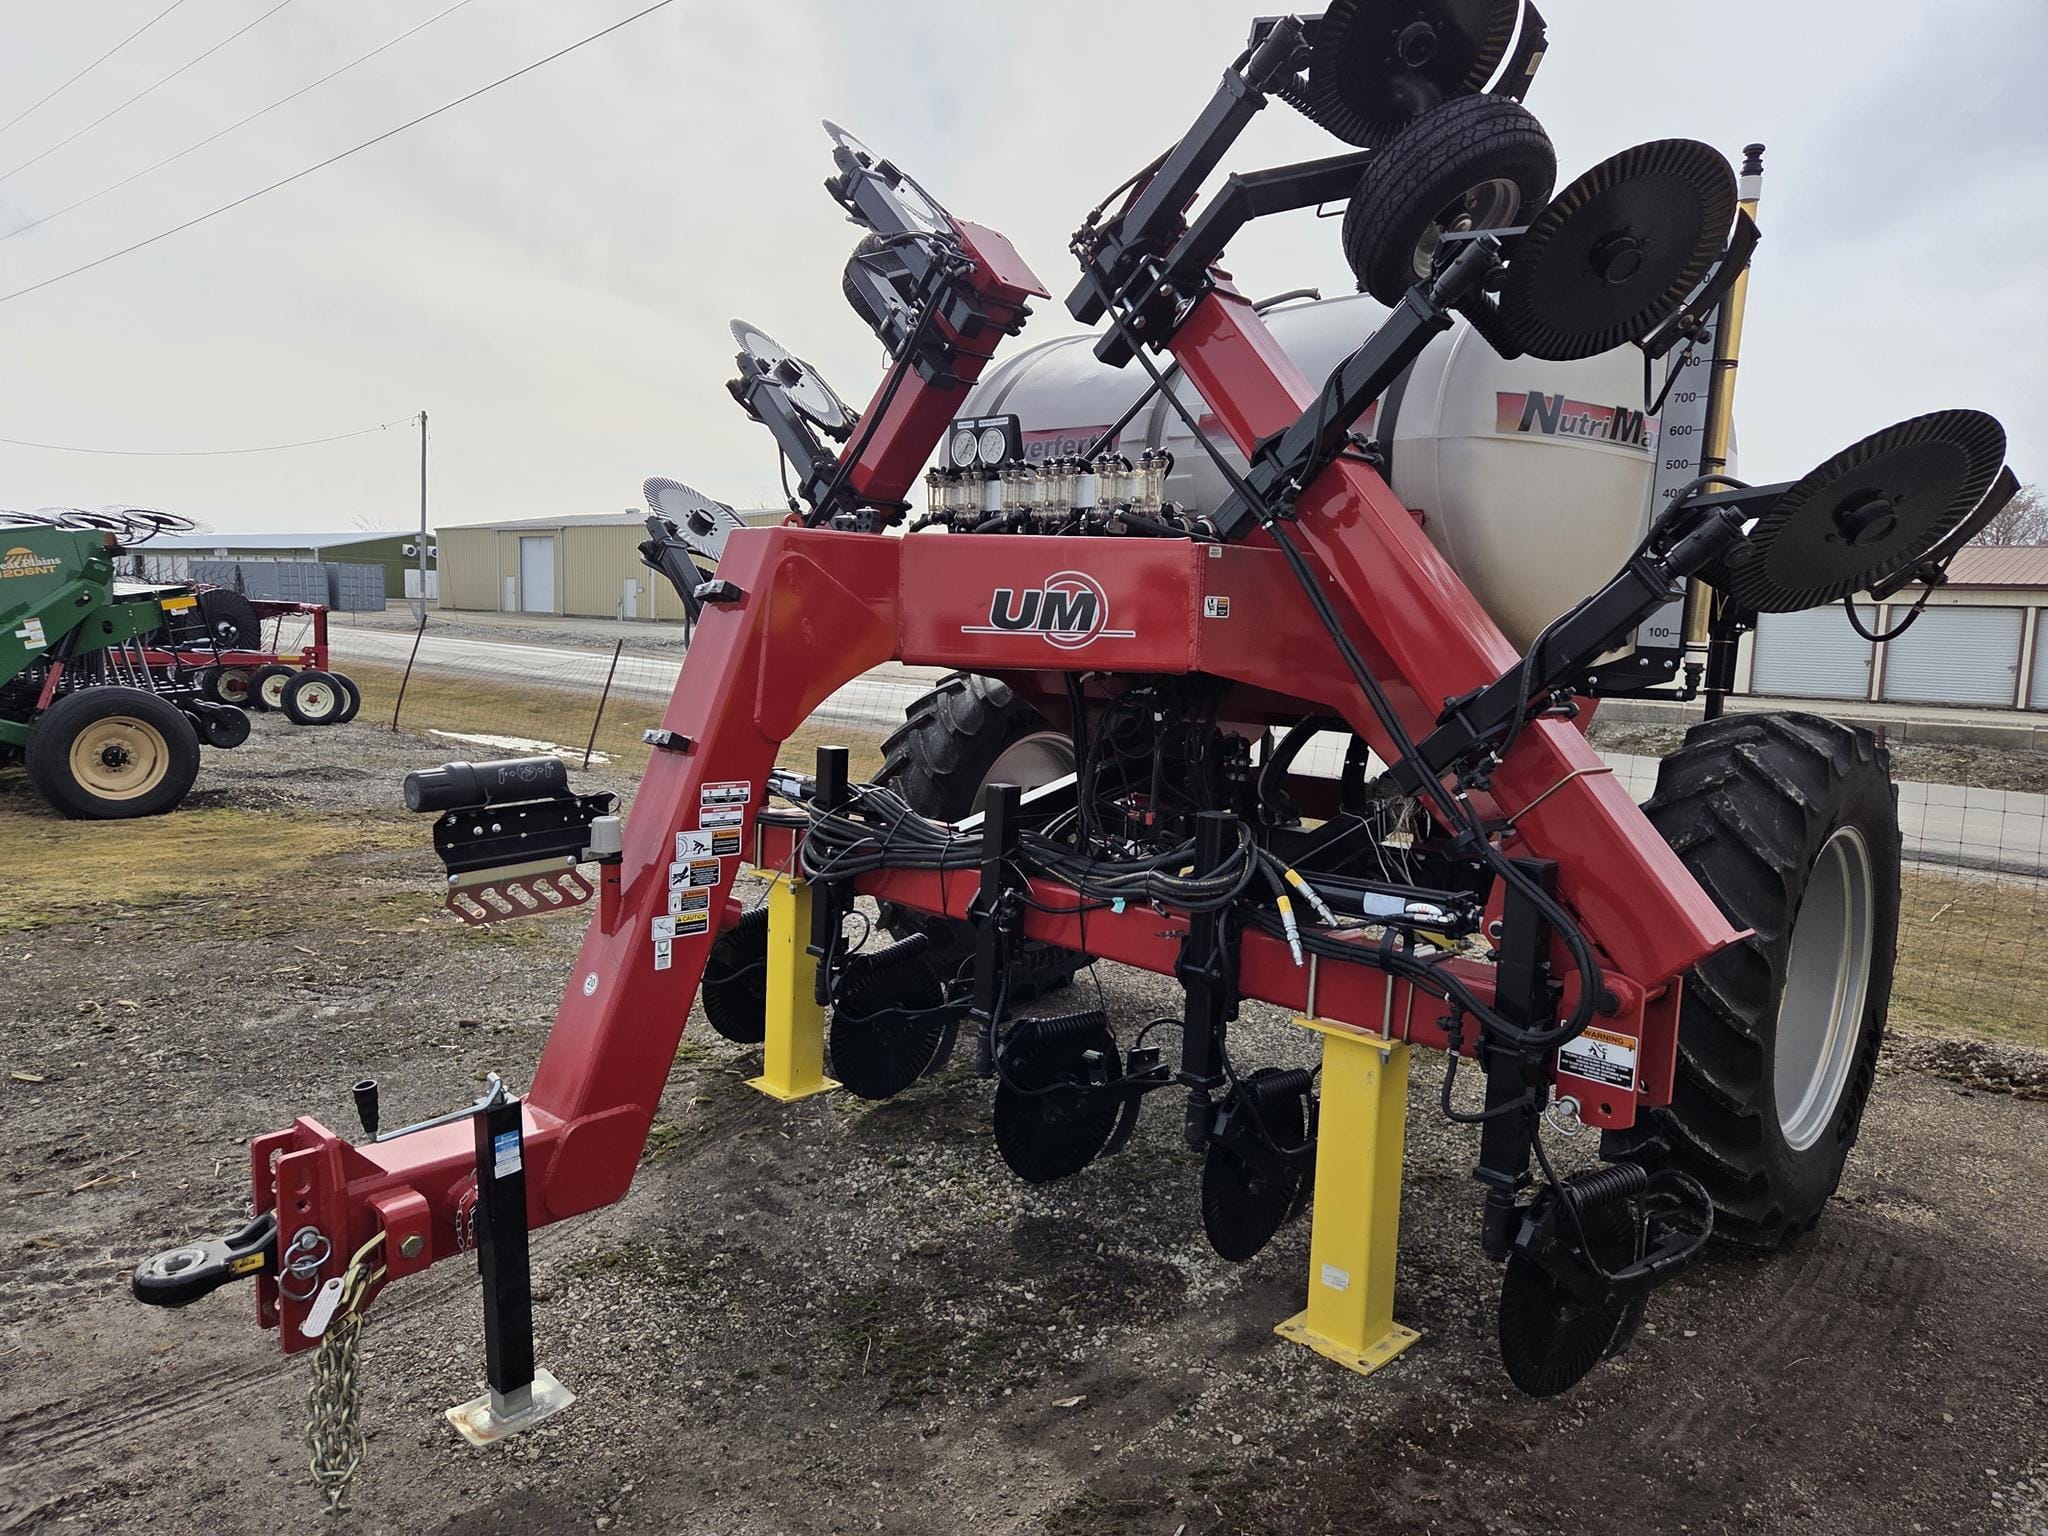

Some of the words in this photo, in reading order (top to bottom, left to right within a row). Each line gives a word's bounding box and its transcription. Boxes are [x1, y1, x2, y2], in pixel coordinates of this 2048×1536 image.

[1684, 356, 1700, 367] 00
[1674, 392, 1696, 403] 700
[1518, 391, 1657, 447] NutriMa
[1669, 425, 1693, 436] 600
[1665, 459, 1689, 470] 500
[22, 557, 61, 568] Plains
[990, 589, 1098, 631] UM
[1649, 627, 1670, 638] 100
[682, 913, 706, 922] CAUTION
[1583, 1029, 1624, 1045] WARNING
